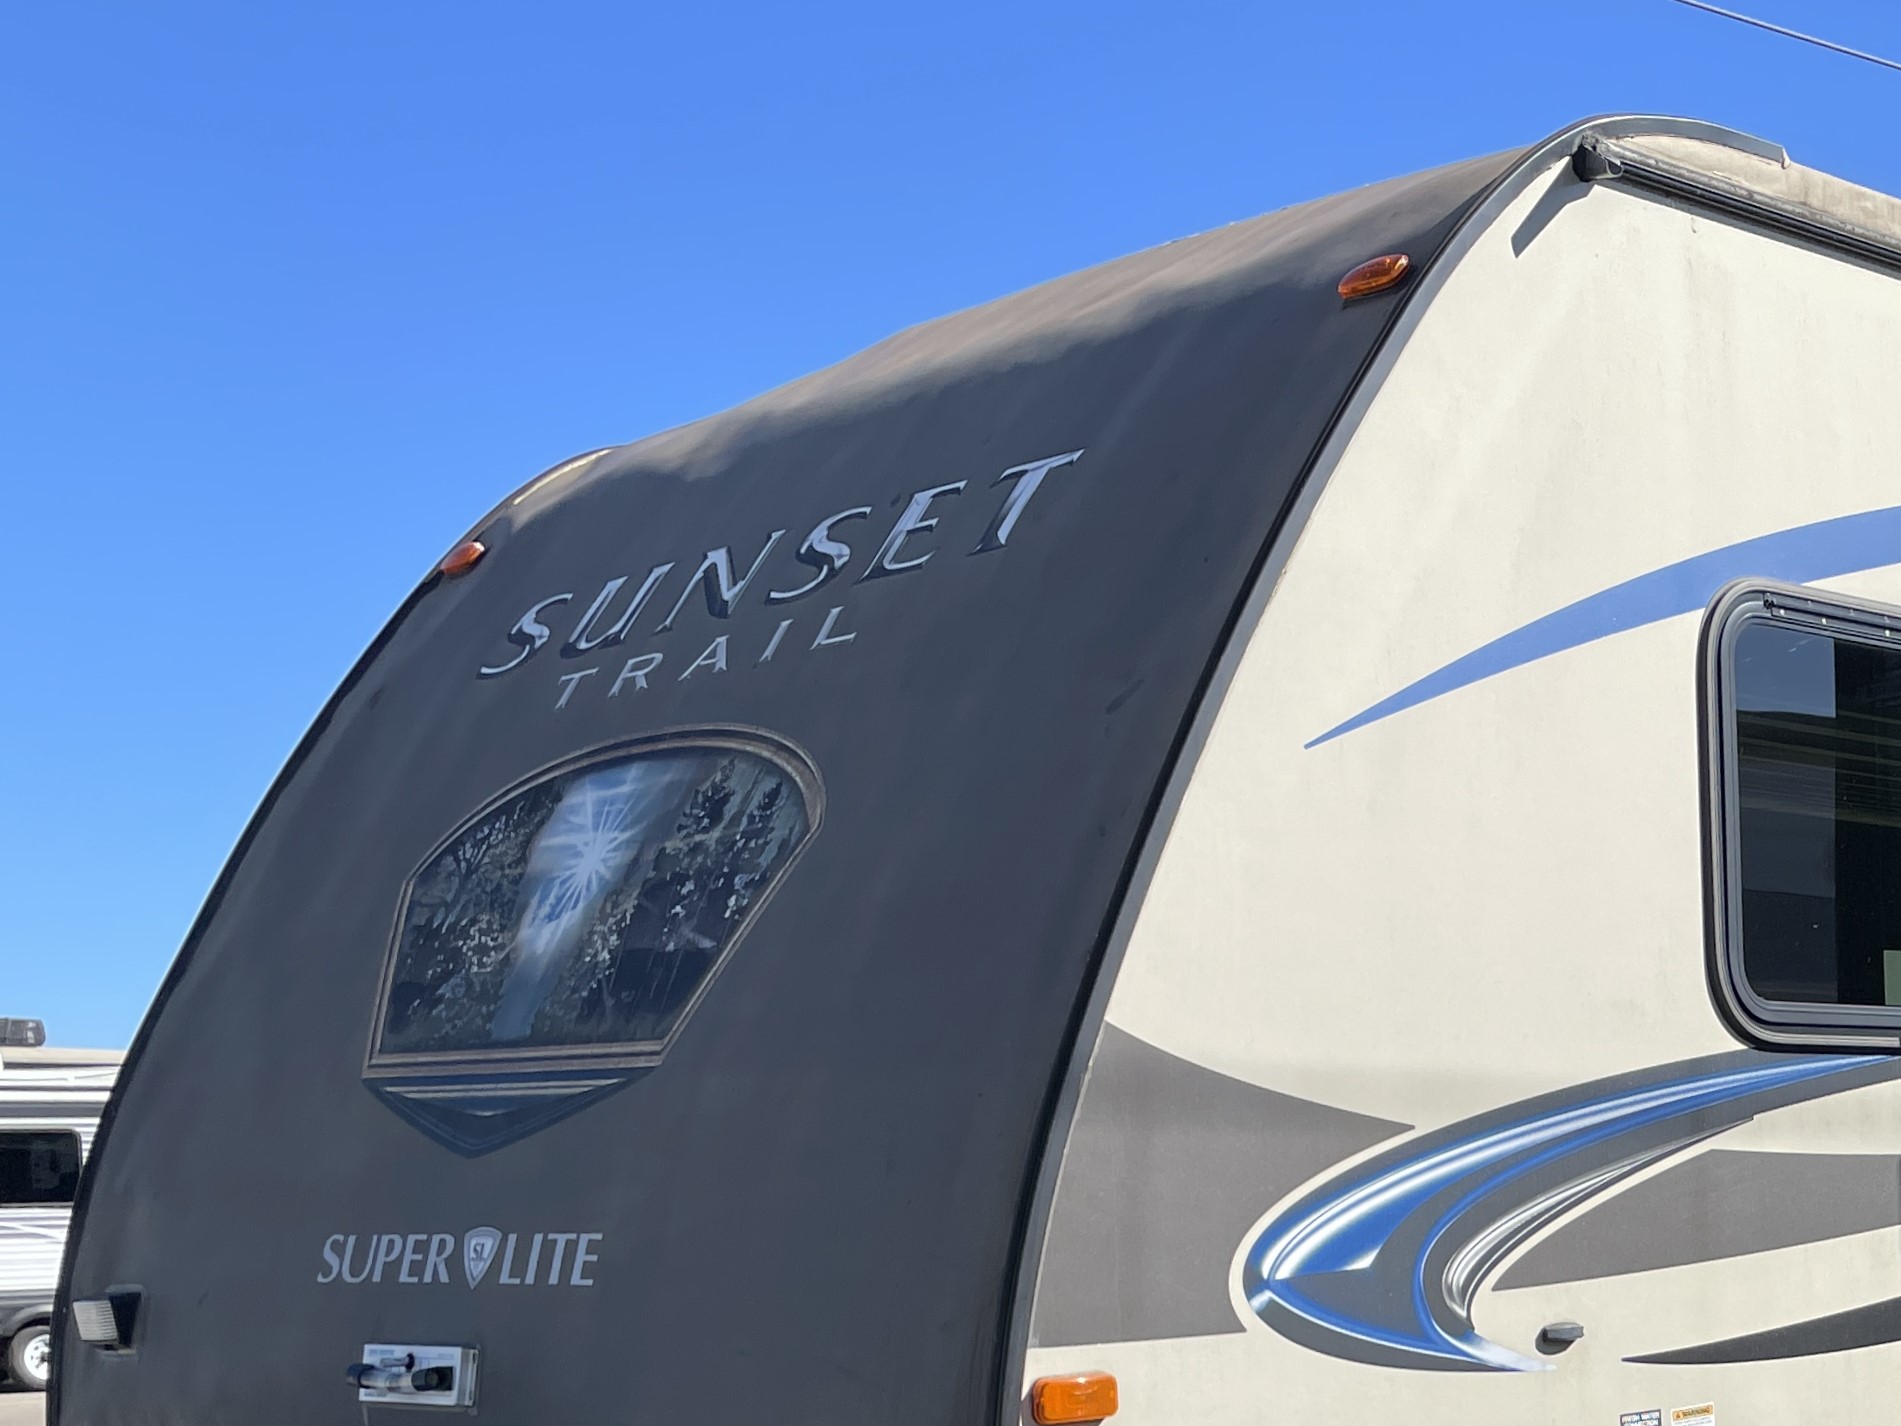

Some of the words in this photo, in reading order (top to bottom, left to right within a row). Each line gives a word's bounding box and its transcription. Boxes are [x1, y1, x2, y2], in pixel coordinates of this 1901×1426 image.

[477, 449, 1085, 679] SUNSET
[555, 606, 857, 710] TRAIL
[317, 1233, 455, 1284] SUPER
[498, 1232, 603, 1286] LITE
